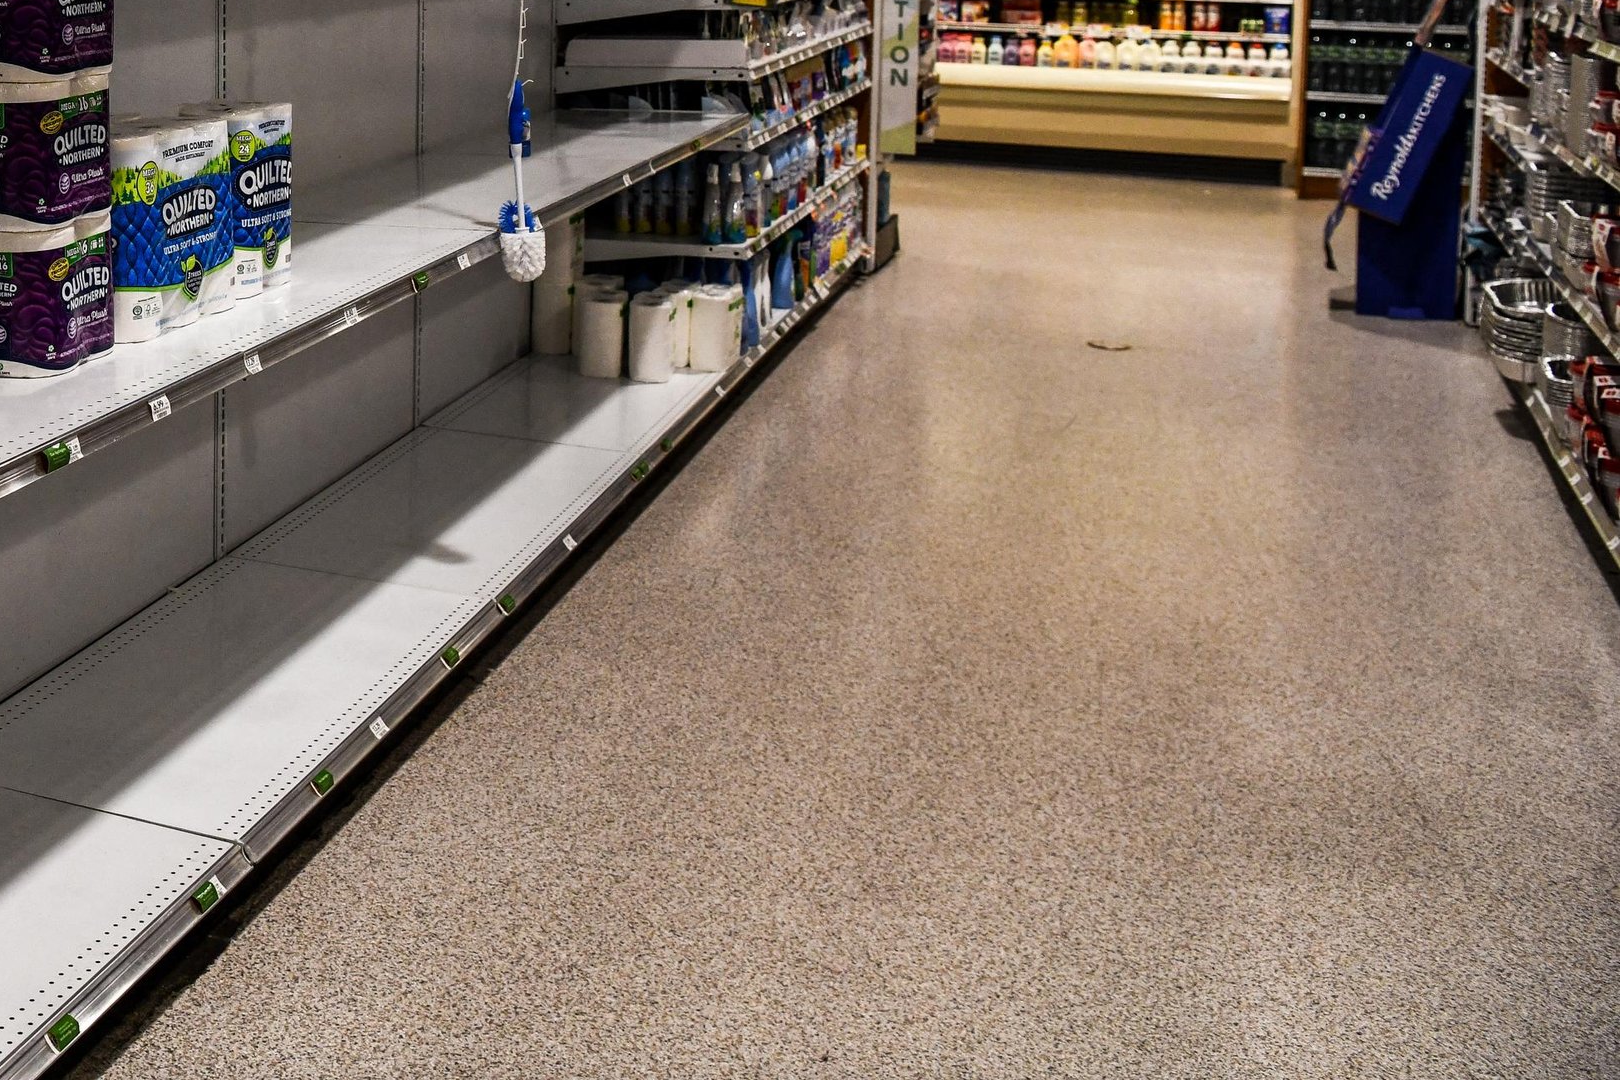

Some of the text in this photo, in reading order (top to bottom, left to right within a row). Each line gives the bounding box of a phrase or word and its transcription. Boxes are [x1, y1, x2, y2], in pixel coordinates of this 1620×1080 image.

[66, 1, 103, 17] NORTHERN
[54, 124, 106, 156] QUILTED
[162, 140, 214, 158] PREMIUM COMFORT
[239, 145, 250, 154] 24
[62, 147, 101, 166] NORTHERN
[1370, 134, 1417, 200] Reynolds
[239, 160, 292, 195] QUILTED
[162, 188, 216, 226] QUILTED
[252, 186, 290, 209] NORTHERN
[170, 212, 209, 236] NORTHERN
[241, 217, 261, 228] ULTRA
[163, 243, 180, 255] ULTRA
[180, 239, 191, 250] SOFT
[61, 267, 110, 302] QUILTED
[70, 288, 105, 311] NORTHERN
